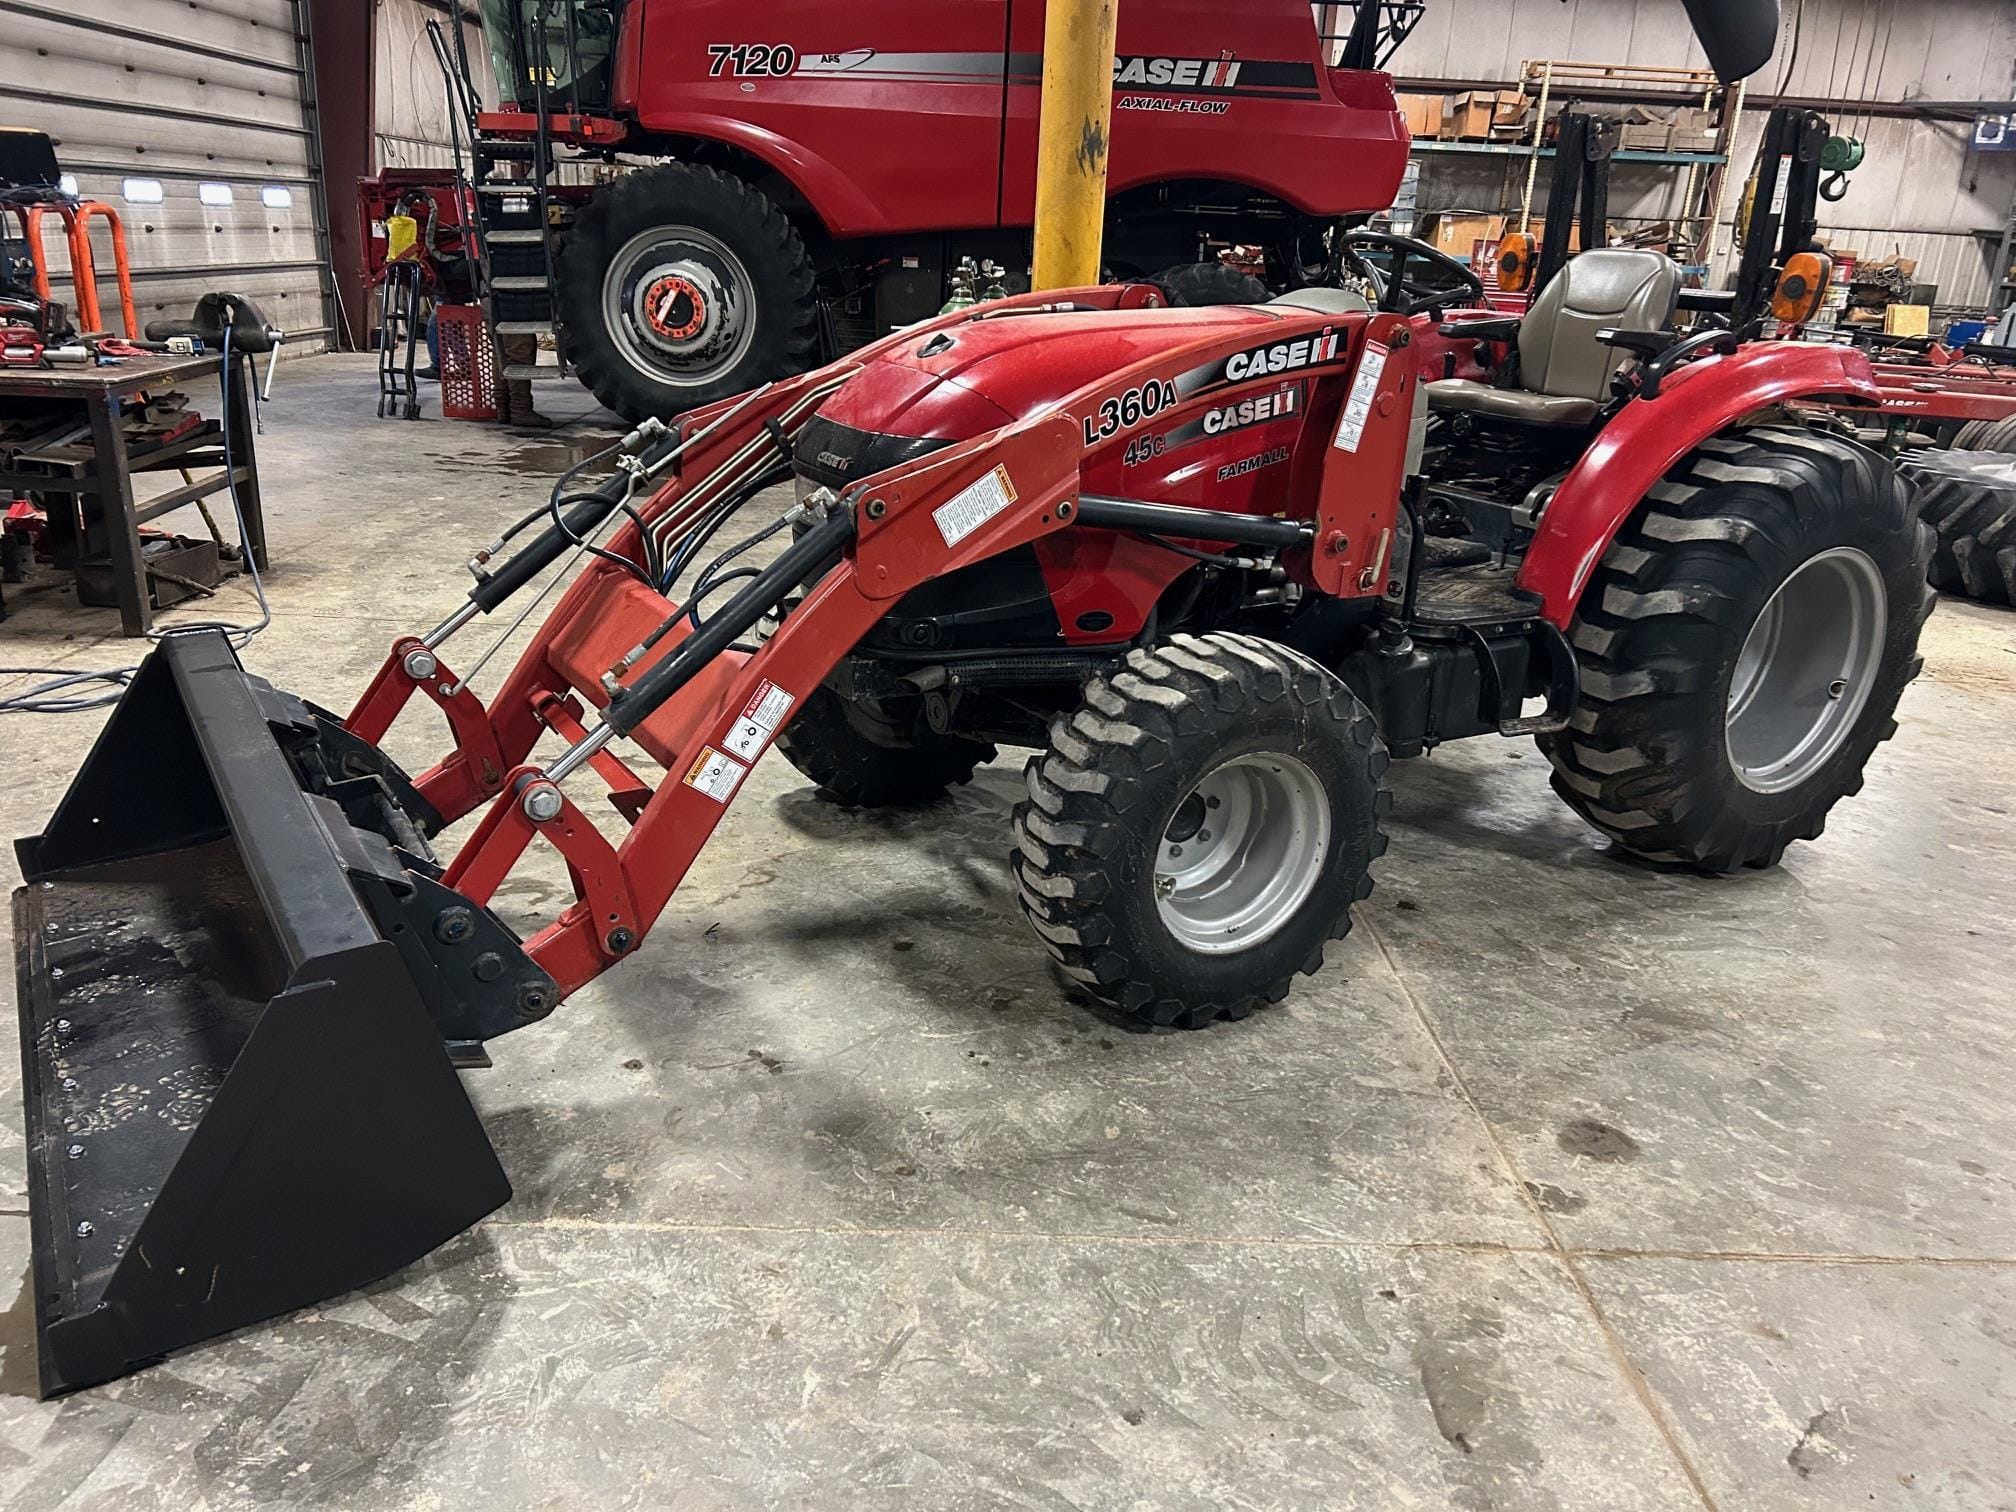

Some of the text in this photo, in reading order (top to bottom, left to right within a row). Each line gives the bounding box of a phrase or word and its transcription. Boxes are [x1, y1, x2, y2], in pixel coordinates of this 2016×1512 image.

[708, 43, 794, 77] 7120
[820, 54, 841, 64] AFS
[1117, 96, 1231, 115] AXIAL-FLOW
[1225, 340, 1309, 382] CASE
[1083, 379, 1177, 448] L360A
[1202, 395, 1274, 435] CASE
[817, 451, 838, 468] CASE
[1123, 433, 1166, 468] 45C
[1216, 447, 1289, 482] FARMALL
[750, 681, 771, 710] DANGER
